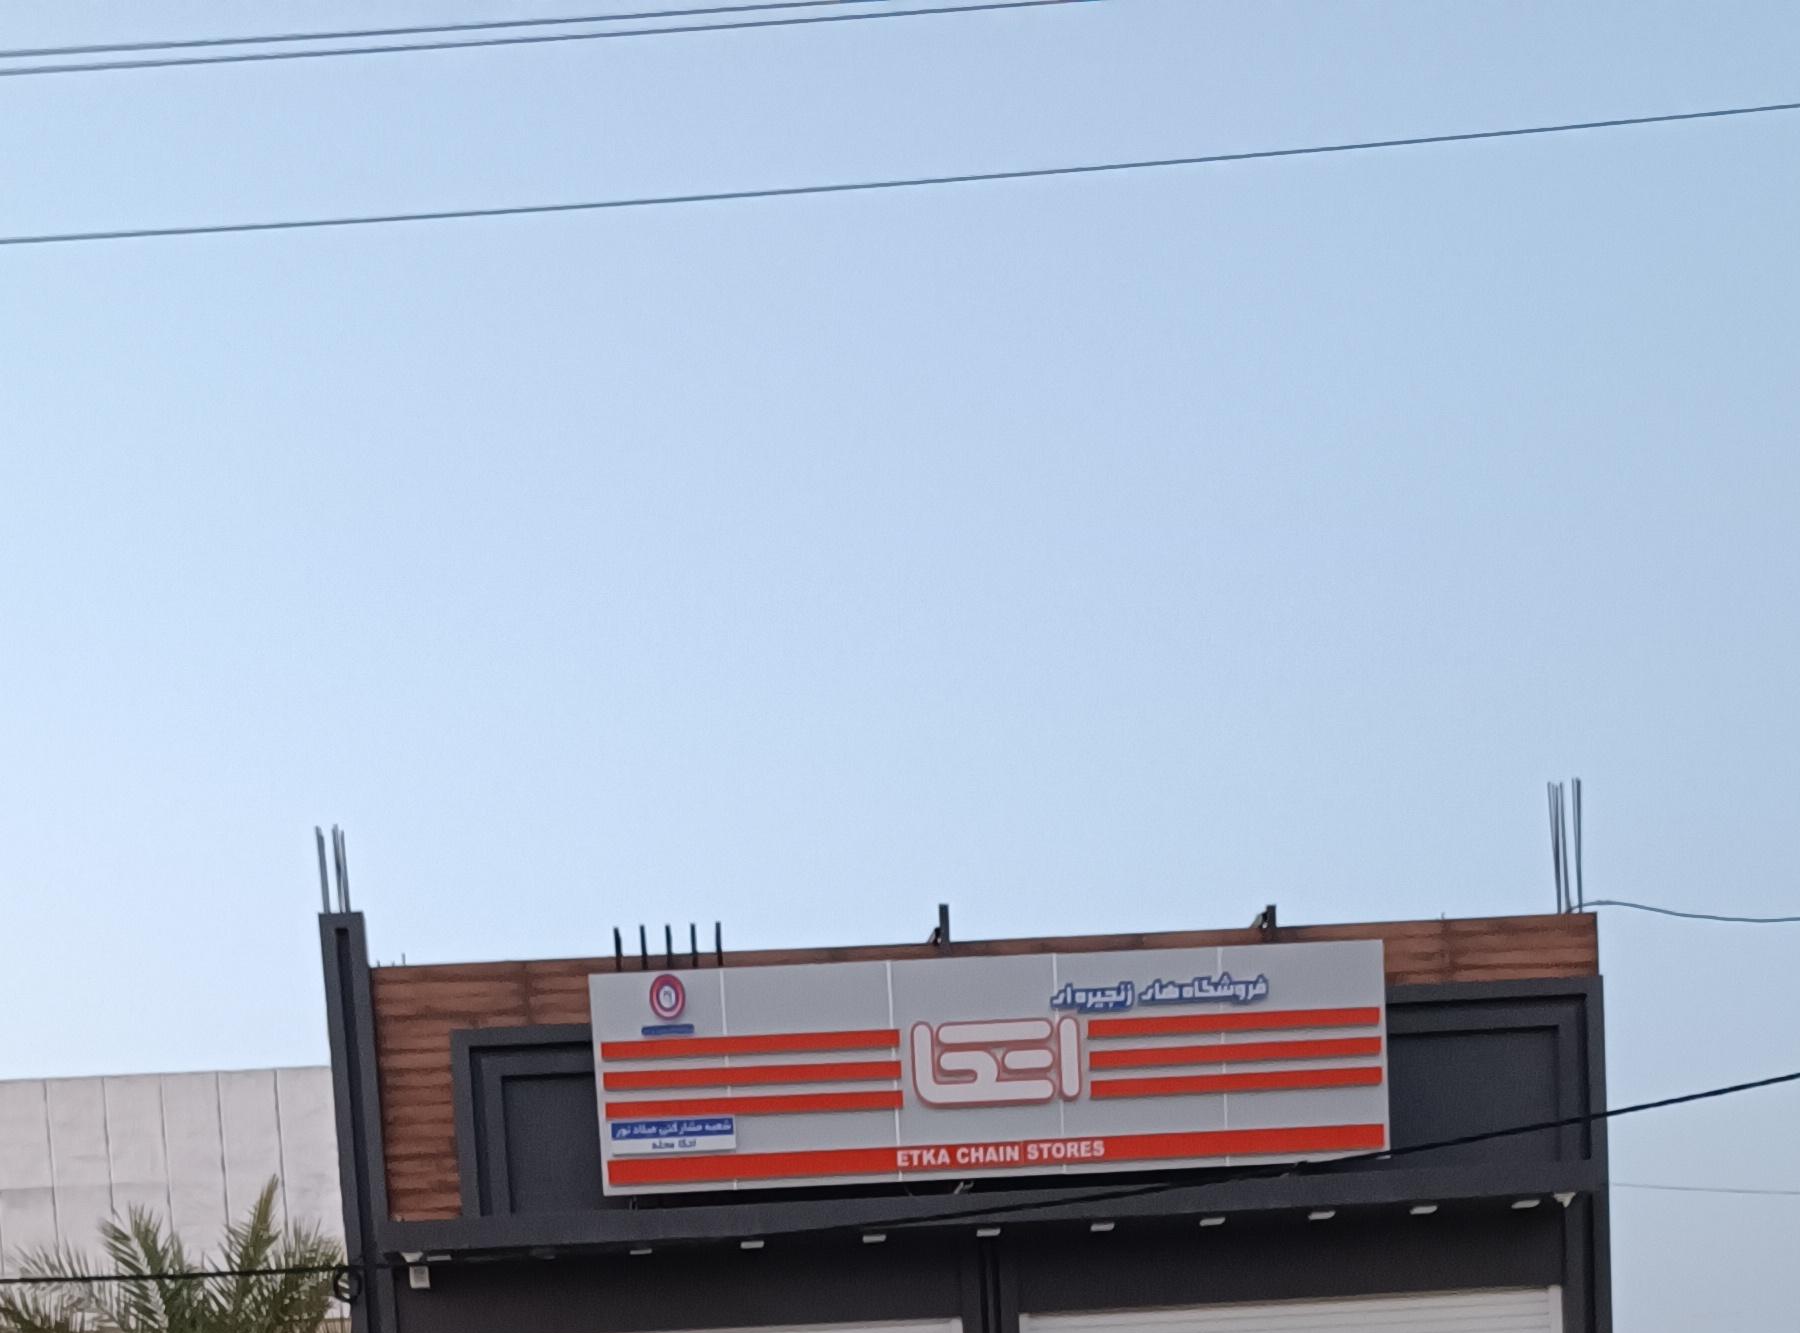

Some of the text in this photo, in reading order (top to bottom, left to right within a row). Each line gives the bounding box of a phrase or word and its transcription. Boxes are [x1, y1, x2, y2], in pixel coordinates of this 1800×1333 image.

[1076, 980, 1134, 1010] زنجیره
[1140, 979, 1181, 1002] های
[1183, 972, 1267, 1002] فروشگاه
[897, 1140, 1105, 1167] ETKA CHAIN STORES
